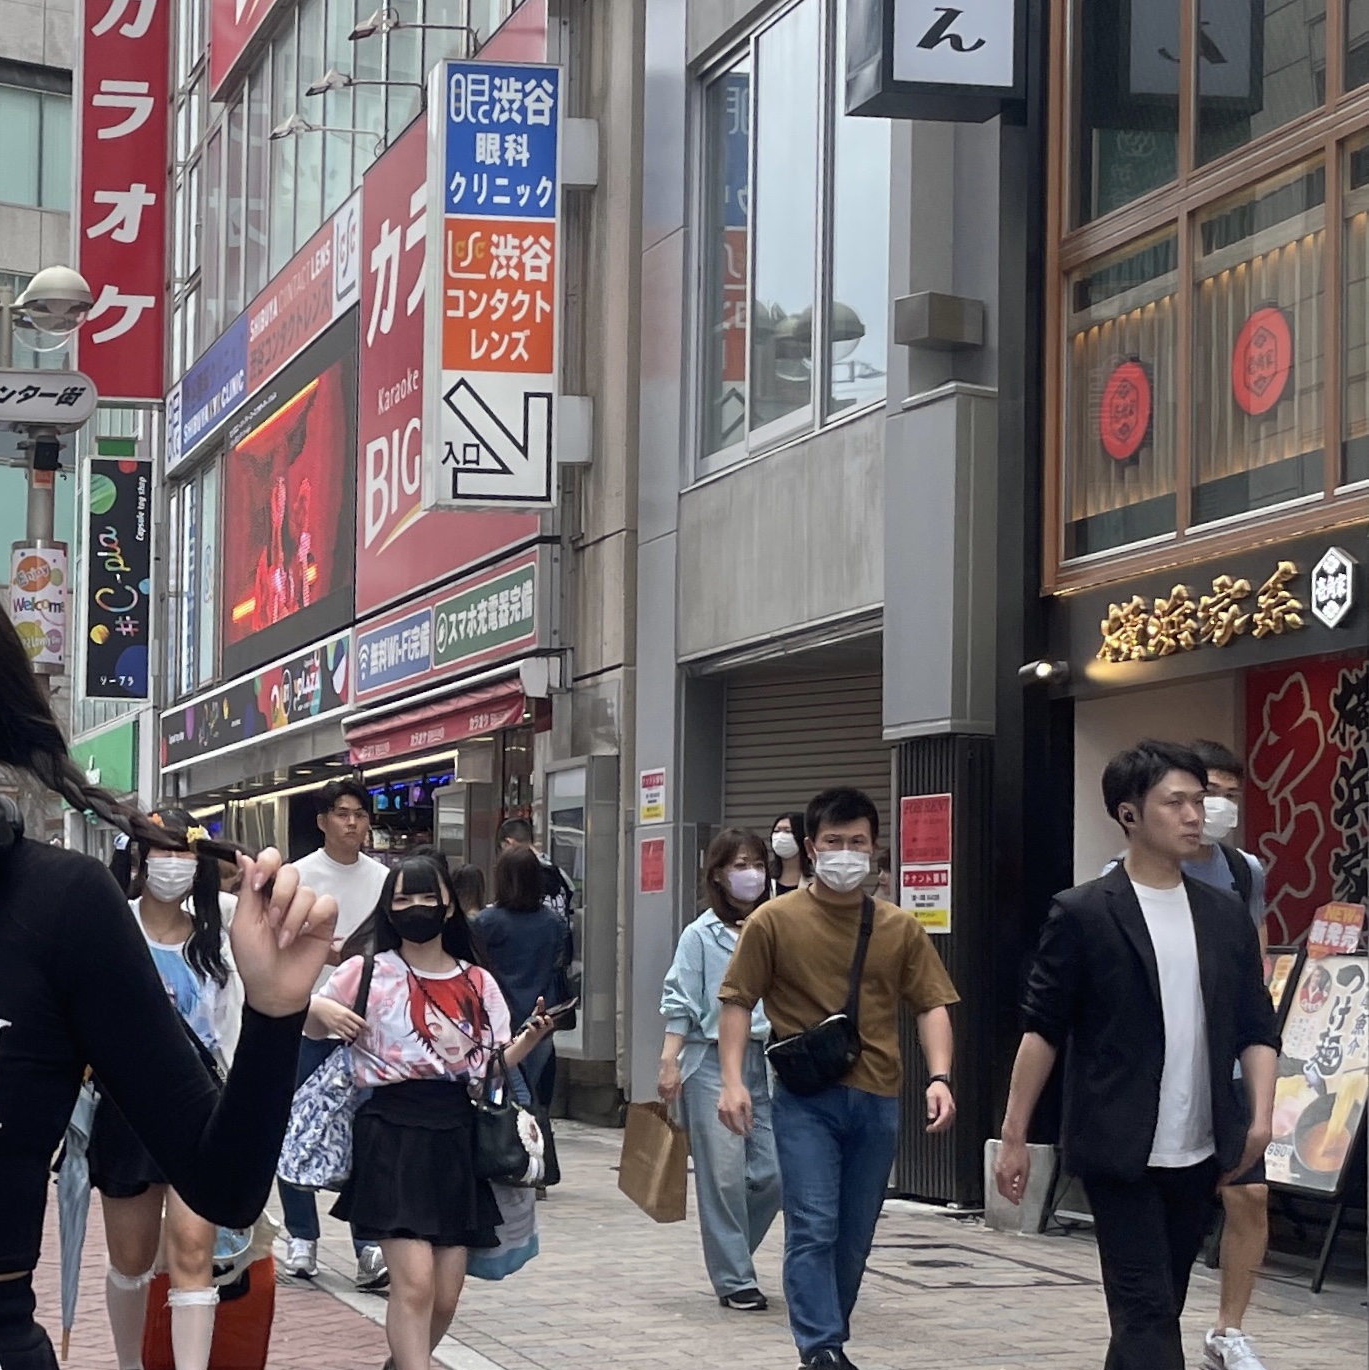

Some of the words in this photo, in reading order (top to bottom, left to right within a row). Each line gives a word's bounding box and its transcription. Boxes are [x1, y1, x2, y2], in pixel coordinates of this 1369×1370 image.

[916, 7, 986, 52] ん
[492, 77, 554, 126] 渋谷
[475, 132, 530, 168] 眼科
[450, 171, 553, 208] クリニック
[489, 233, 552, 282] 渋谷
[250, 292, 279, 342] SHIBUYA
[310, 240, 331, 281] LENS
[446, 289, 551, 323] コンタクト
[470, 328, 530, 362] レンズ
[183, 411, 209, 445] SHIBUYA
[221, 369, 245, 411] CLINIC
[378, 367, 419, 416] Karaoke
[441, 441, 480, 466] 入口
[364, 417, 421, 550] BIG
[447, 578, 534, 645] スマホ充電器完備
